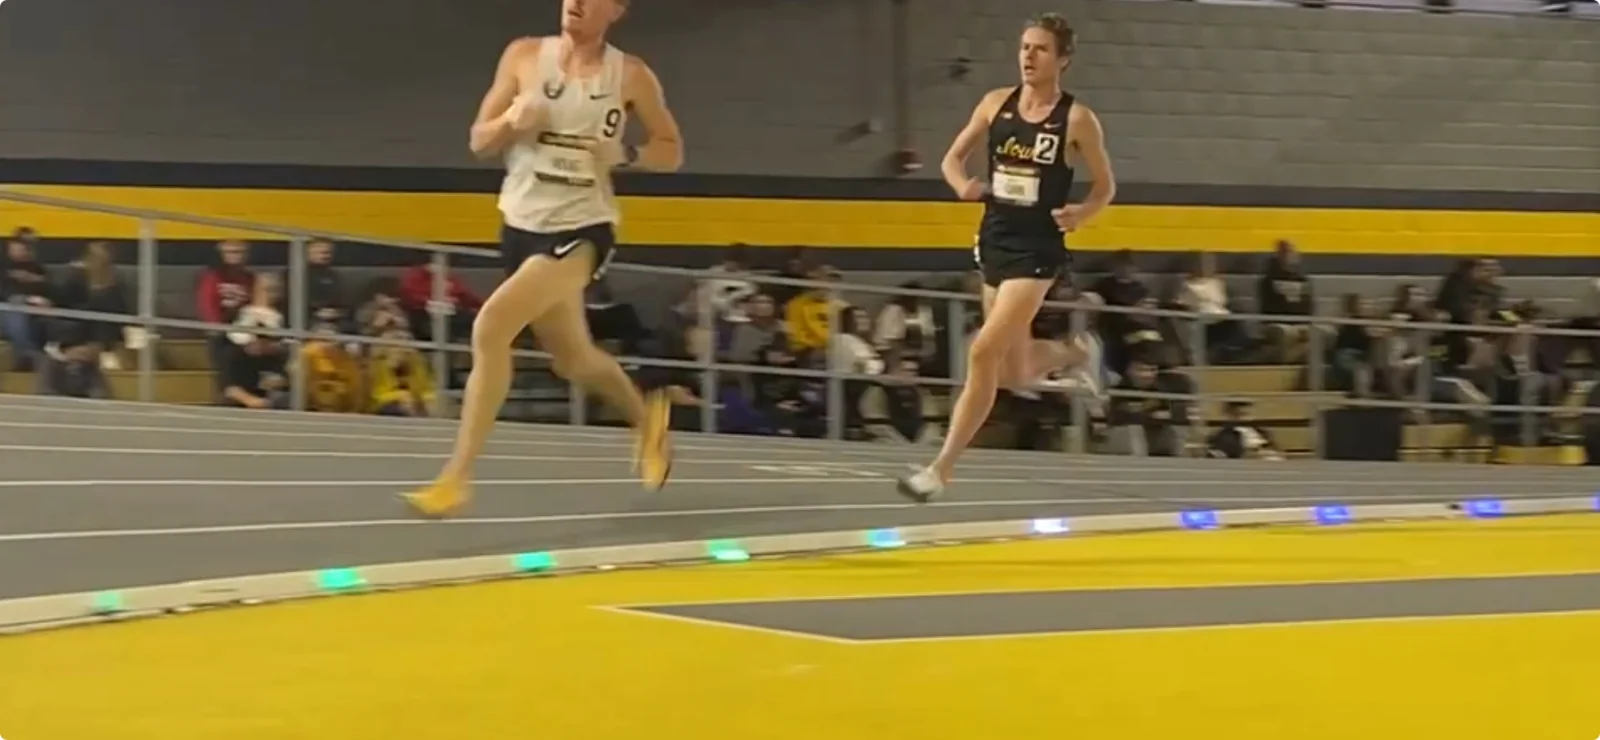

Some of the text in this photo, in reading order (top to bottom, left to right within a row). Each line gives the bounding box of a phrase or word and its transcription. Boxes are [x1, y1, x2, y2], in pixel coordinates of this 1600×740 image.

[603, 108, 621, 138] 9
[996, 136, 1037, 159] Iow
[1036, 137, 1055, 161] 2
